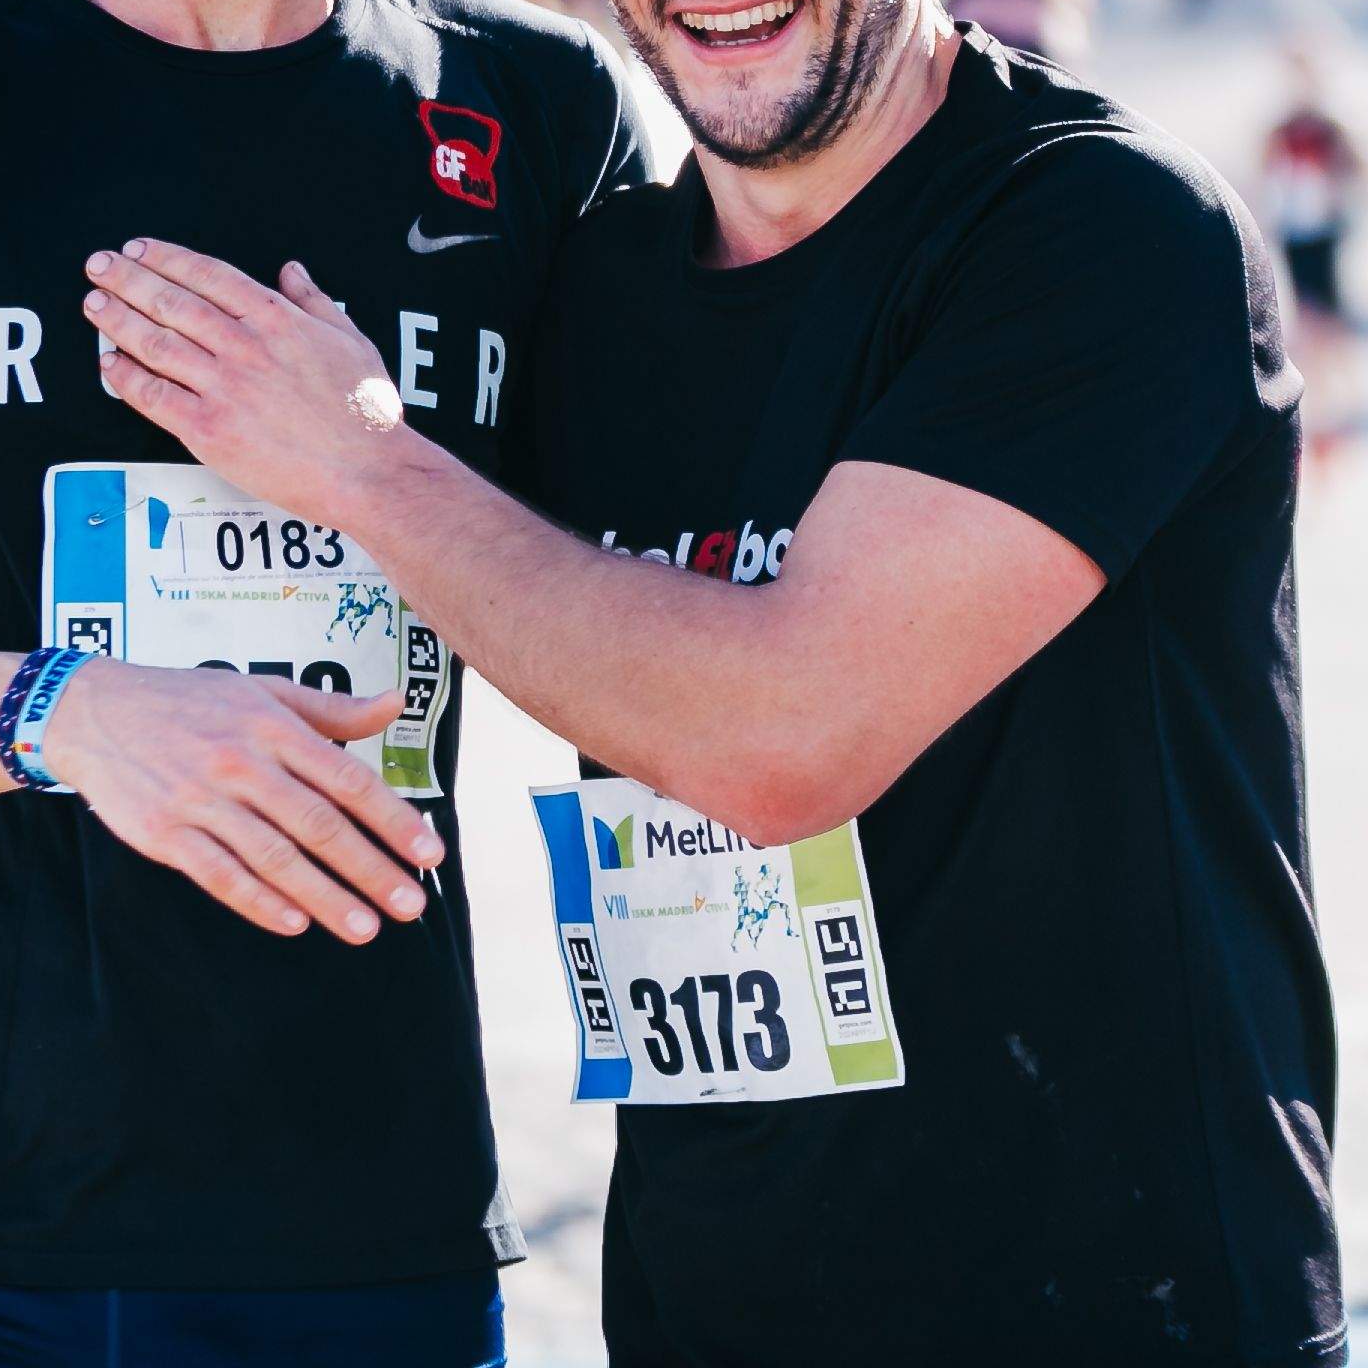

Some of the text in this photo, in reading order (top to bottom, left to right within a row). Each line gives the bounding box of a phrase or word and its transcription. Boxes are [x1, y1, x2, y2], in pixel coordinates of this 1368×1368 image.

[435, 144, 466, 181] GF
[216, 519, 345, 572] 0183
[195, 589, 226, 600] 15KM
[232, 589, 281, 601] MADRID
[645, 818, 767, 859] MetLi
[603, 894, 630, 920] VIII
[657, 905, 695, 916] MADRID
[630, 970, 792, 1076] 3173
